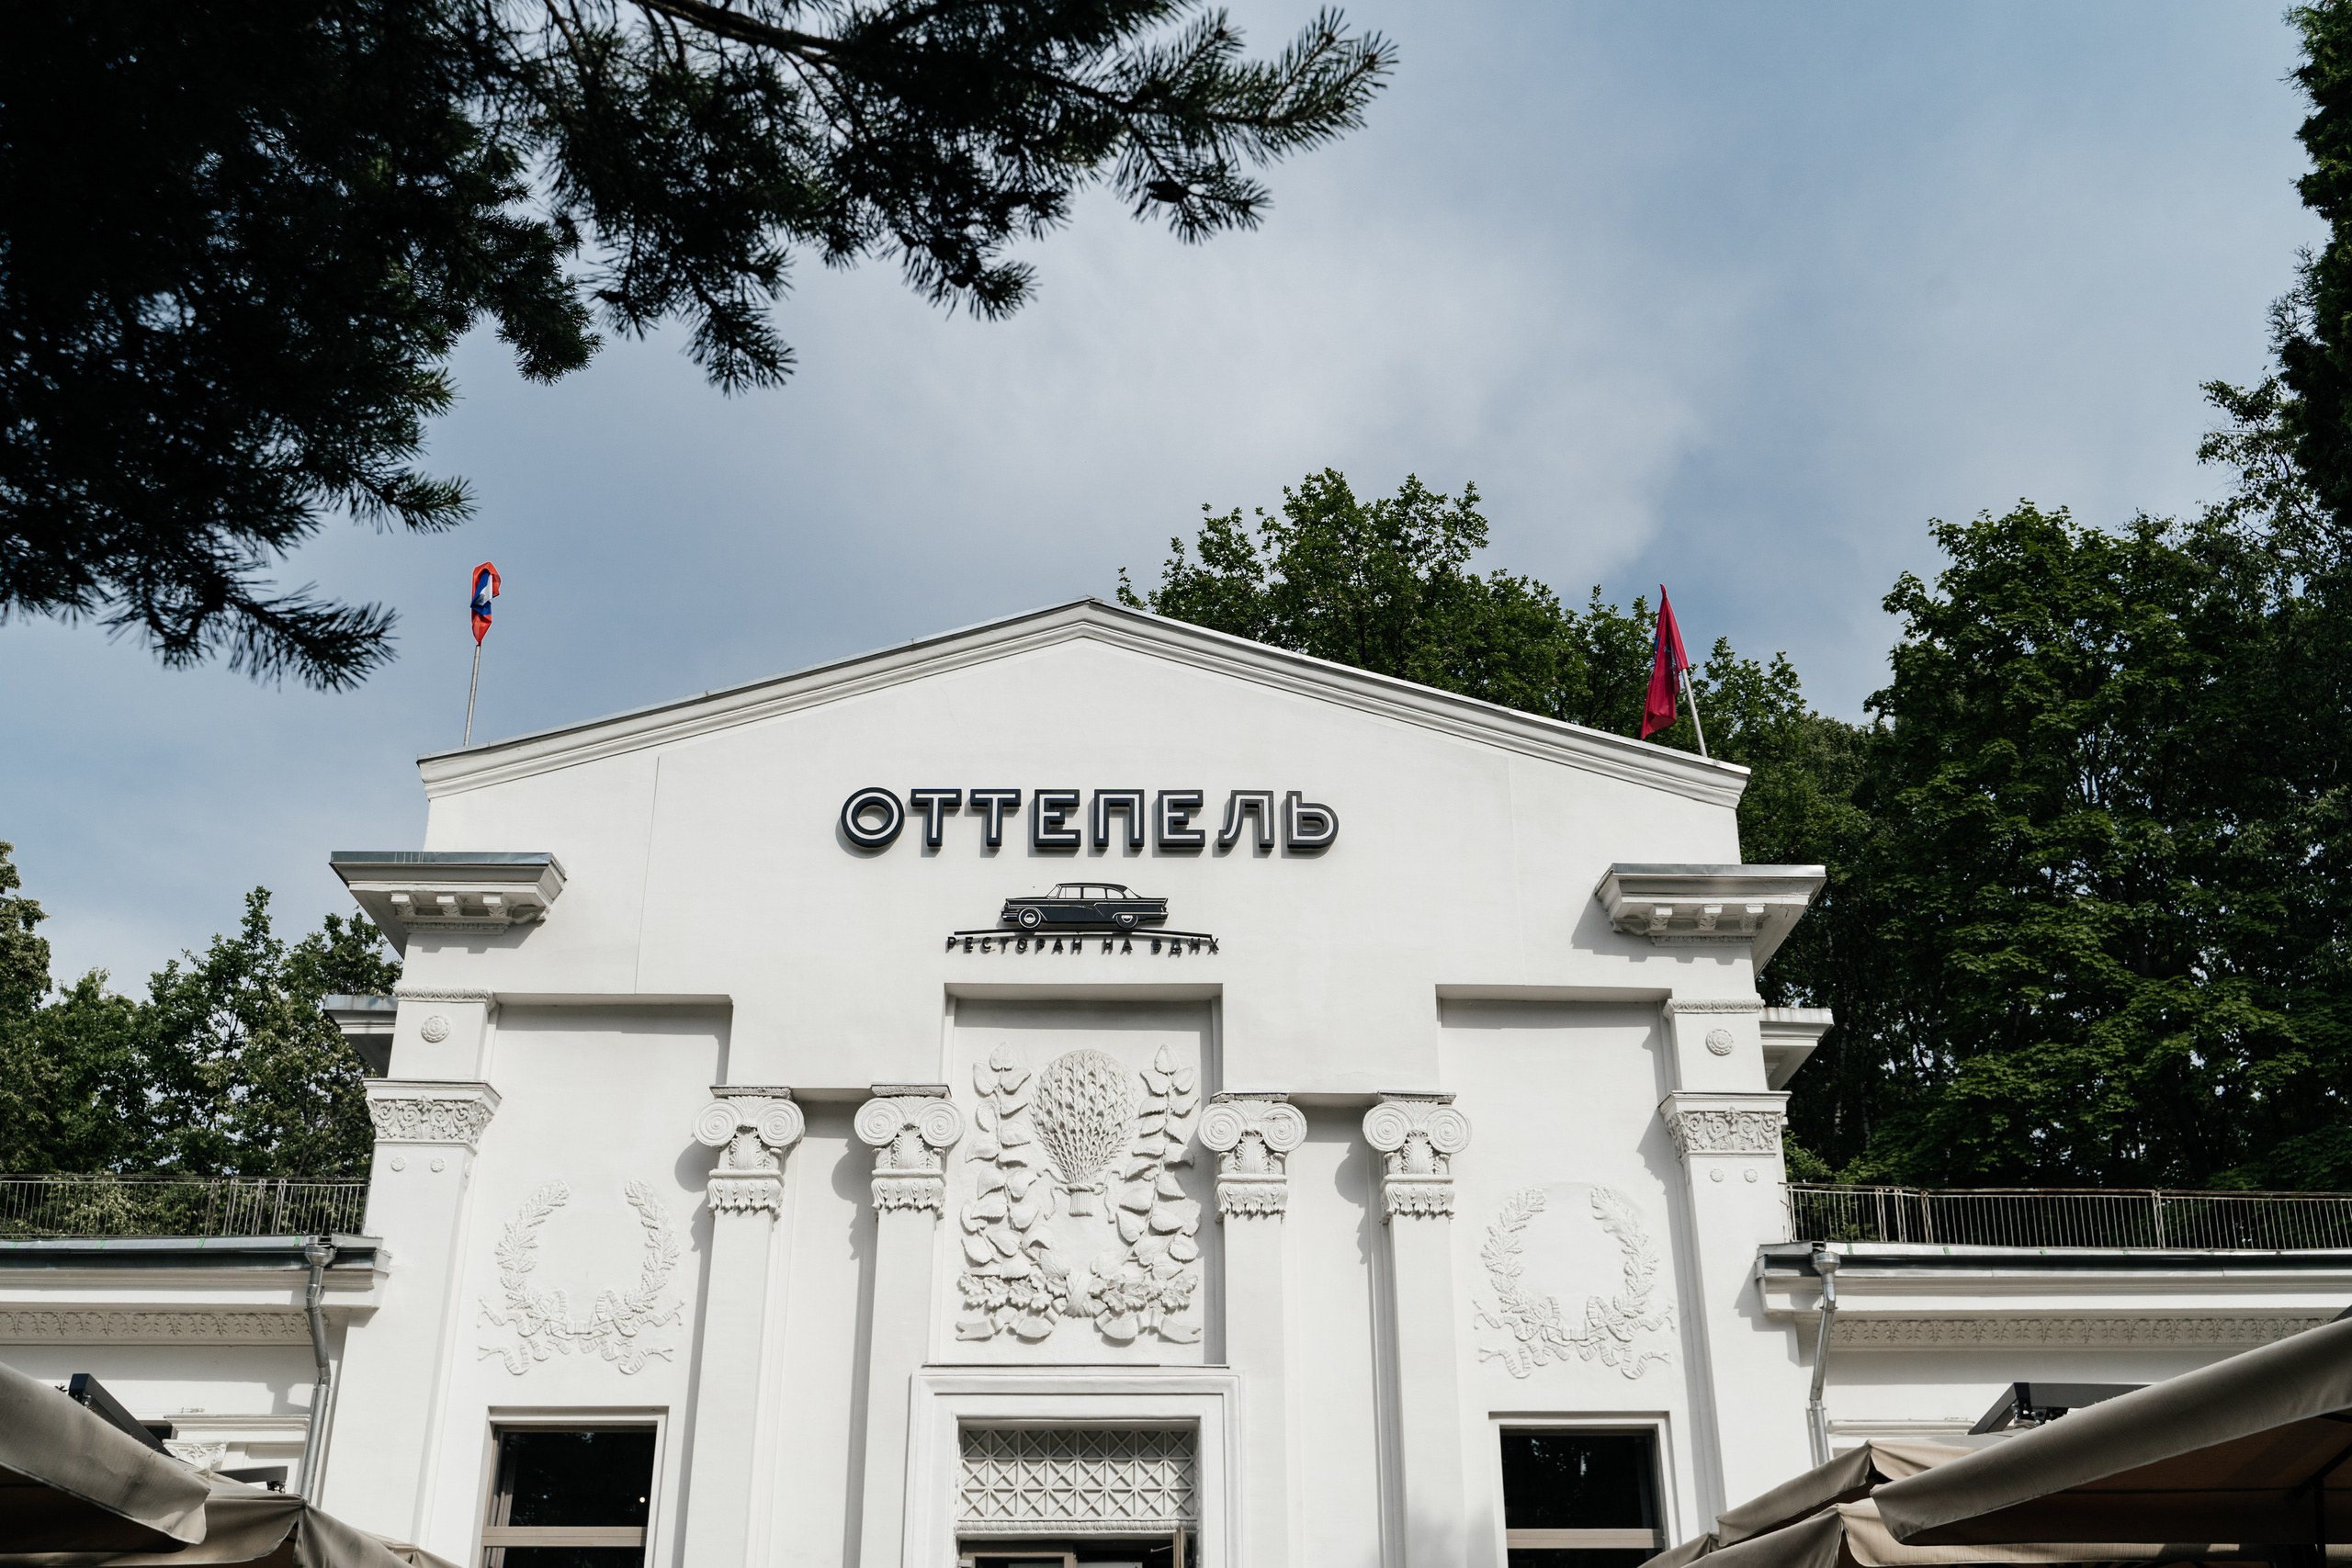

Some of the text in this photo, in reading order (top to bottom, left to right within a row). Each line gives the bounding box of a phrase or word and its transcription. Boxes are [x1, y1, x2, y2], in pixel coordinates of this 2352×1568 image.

[841, 787, 1340, 849] ОТТЕПЕЛЬ
[947, 936, 1219, 953] РЕСТОРАН НА ВДНХ
